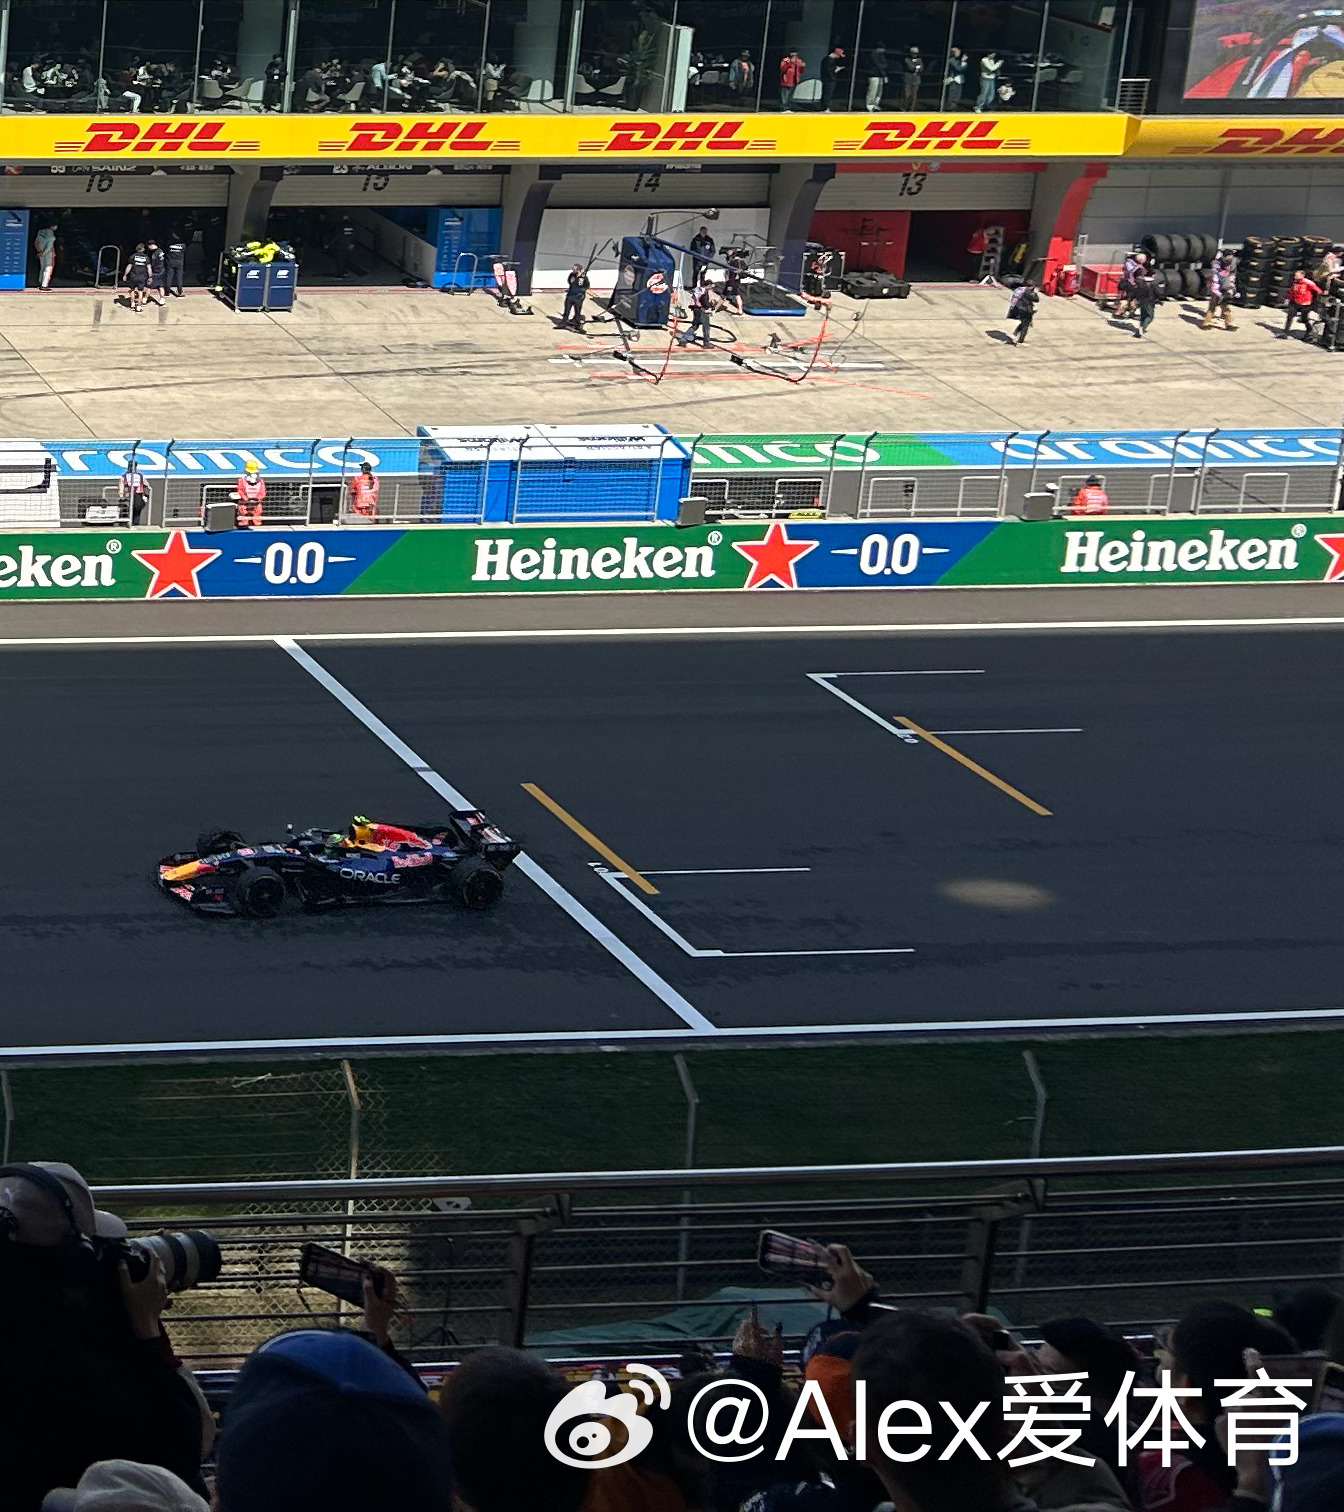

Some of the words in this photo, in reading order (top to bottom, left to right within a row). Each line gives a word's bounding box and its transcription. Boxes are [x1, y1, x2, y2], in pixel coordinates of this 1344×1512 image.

[82, 122, 234, 152] DHL
[346, 122, 494, 152] DHL
[605, 120, 750, 151] DHL
[860, 120, 1006, 150] DHL
[85, 174, 114, 193] 16
[632, 172, 661, 193] 14
[898, 172, 928, 197] 13
[263, 542, 326, 585] 0.0
[860, 533, 920, 576] 0.0
[340, 867, 402, 885] ORACLE
